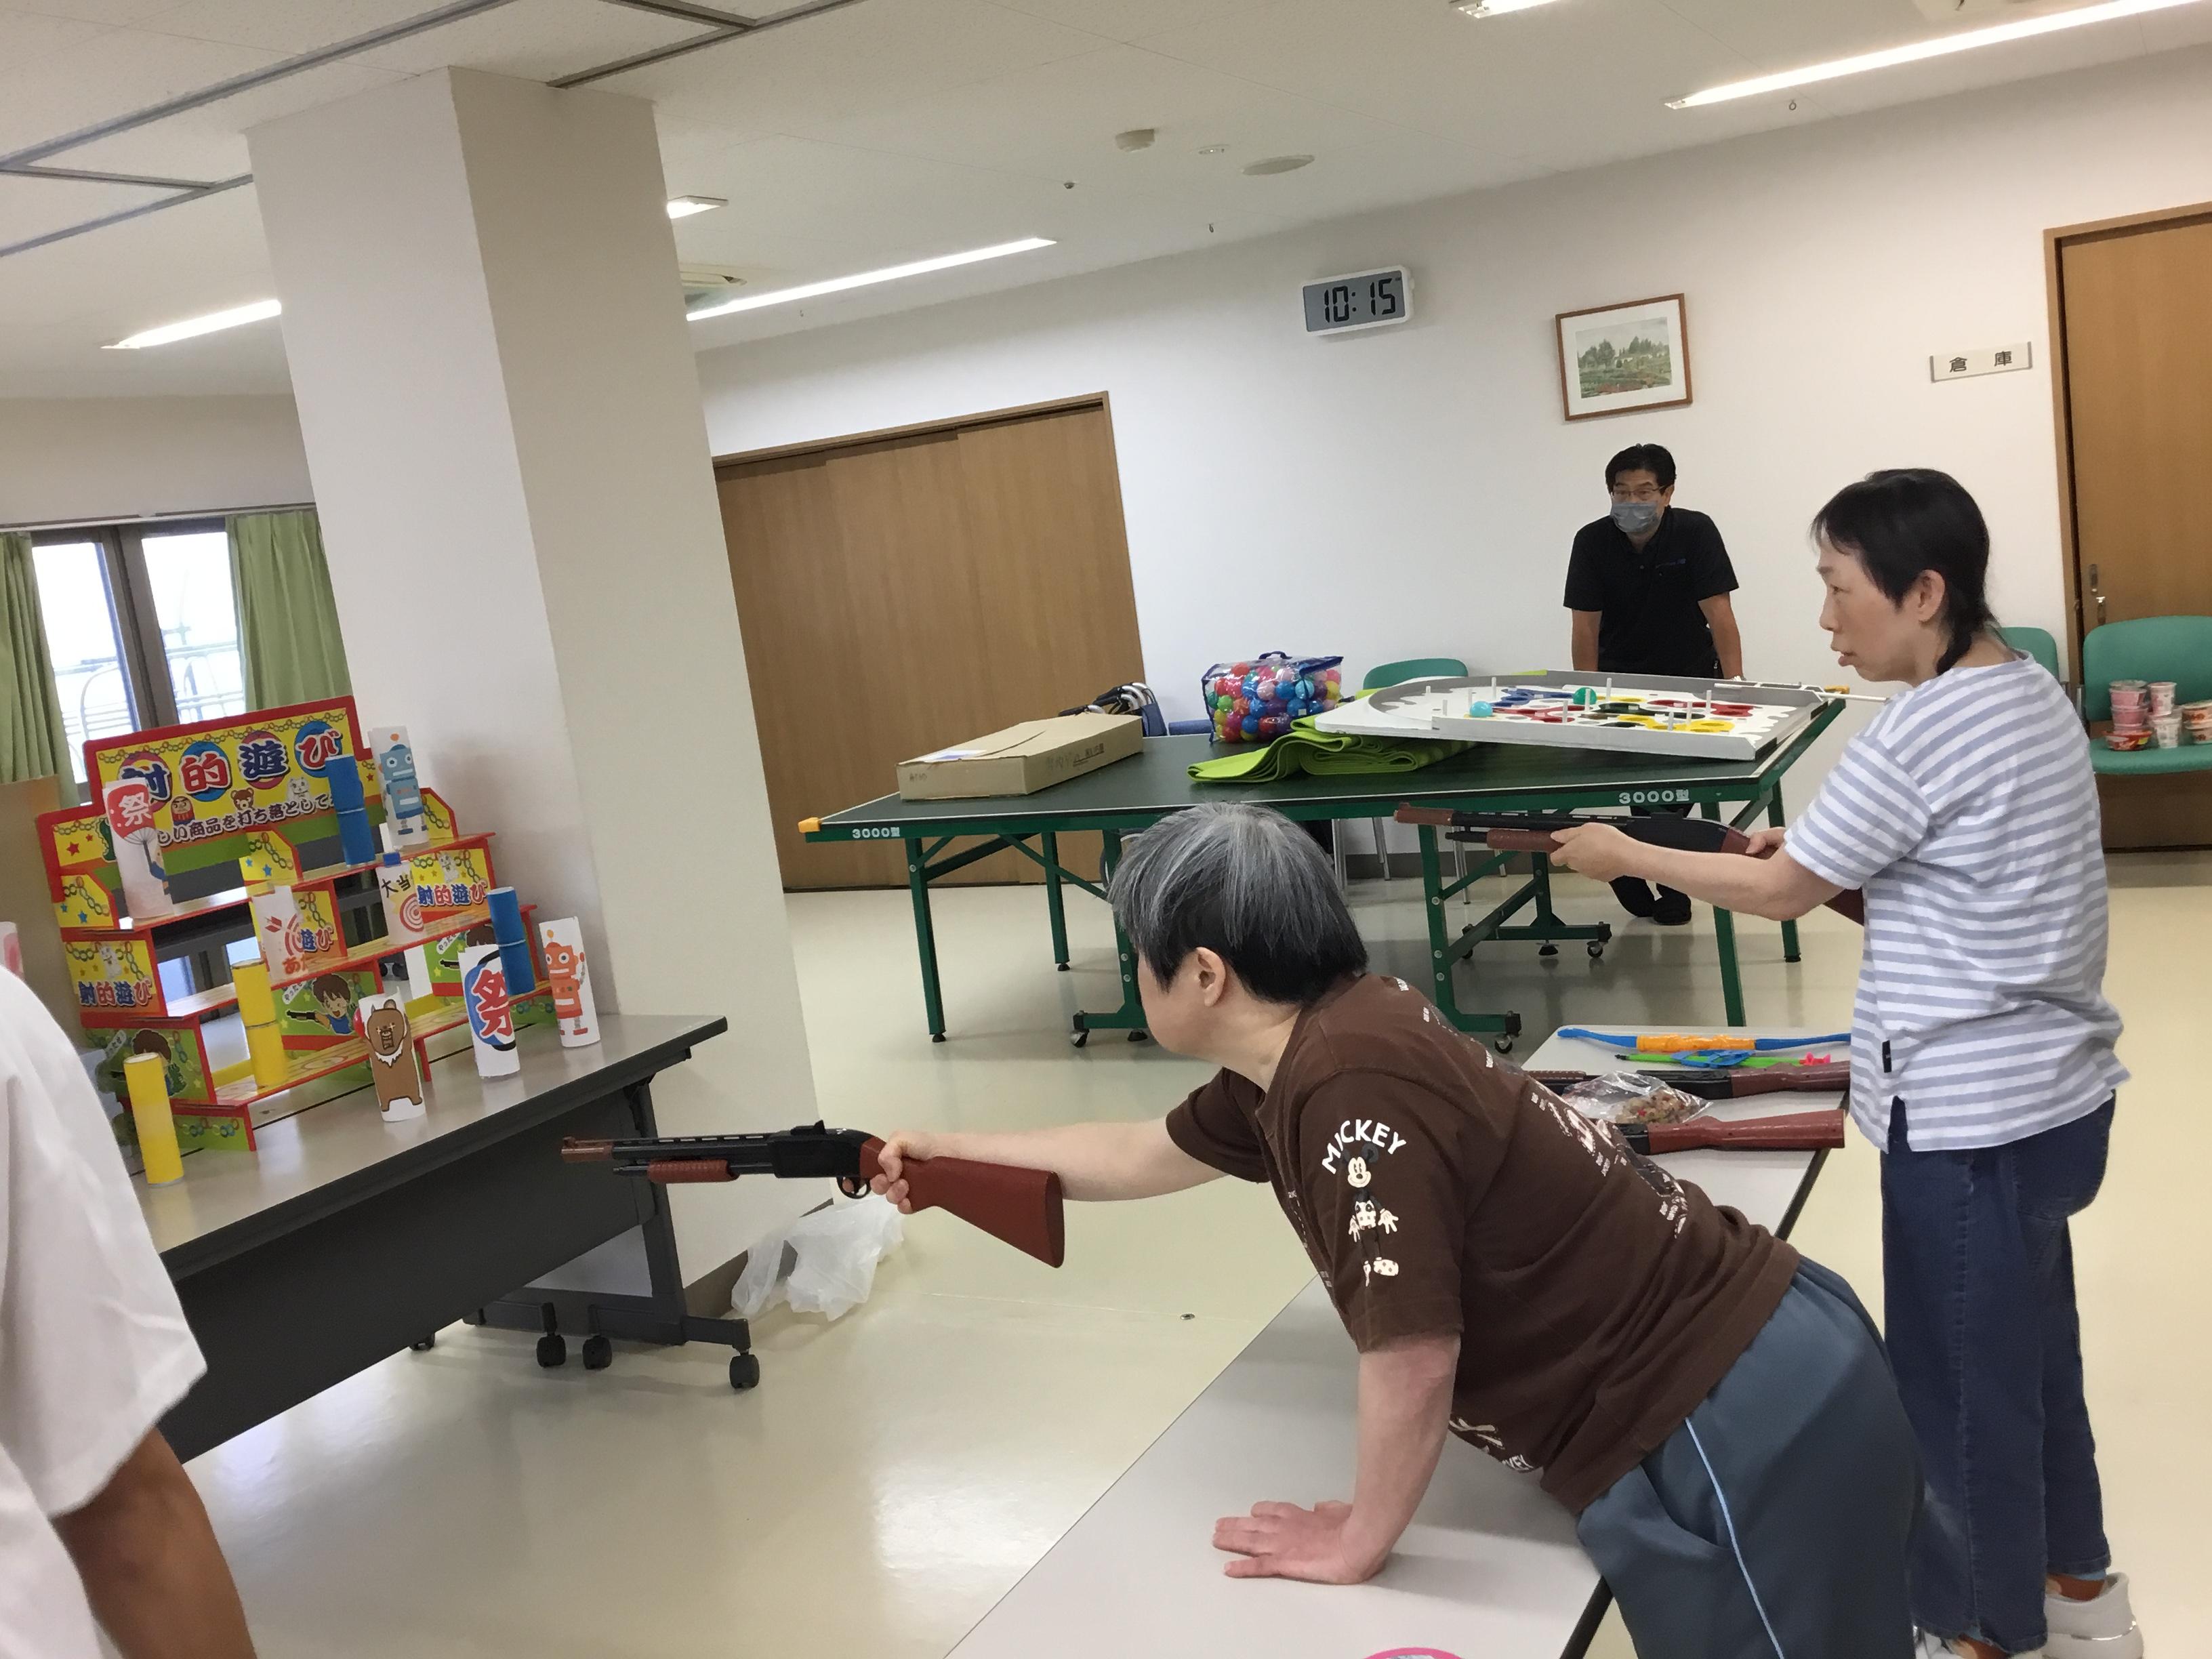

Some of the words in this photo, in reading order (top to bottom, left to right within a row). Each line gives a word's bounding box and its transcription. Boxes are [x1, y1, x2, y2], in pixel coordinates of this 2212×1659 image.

[1324, 278, 1395, 323] 10:15
[1949, 350, 2013, 373] 倉庫
[119, 793, 152, 825] 祭
[157, 794, 334, 846] しい商品を打ち落として
[416, 879, 488, 907] 射的遊び
[77, 977, 152, 1006] 射的遊び
[1322, 1119, 1407, 1174] MICKEY
